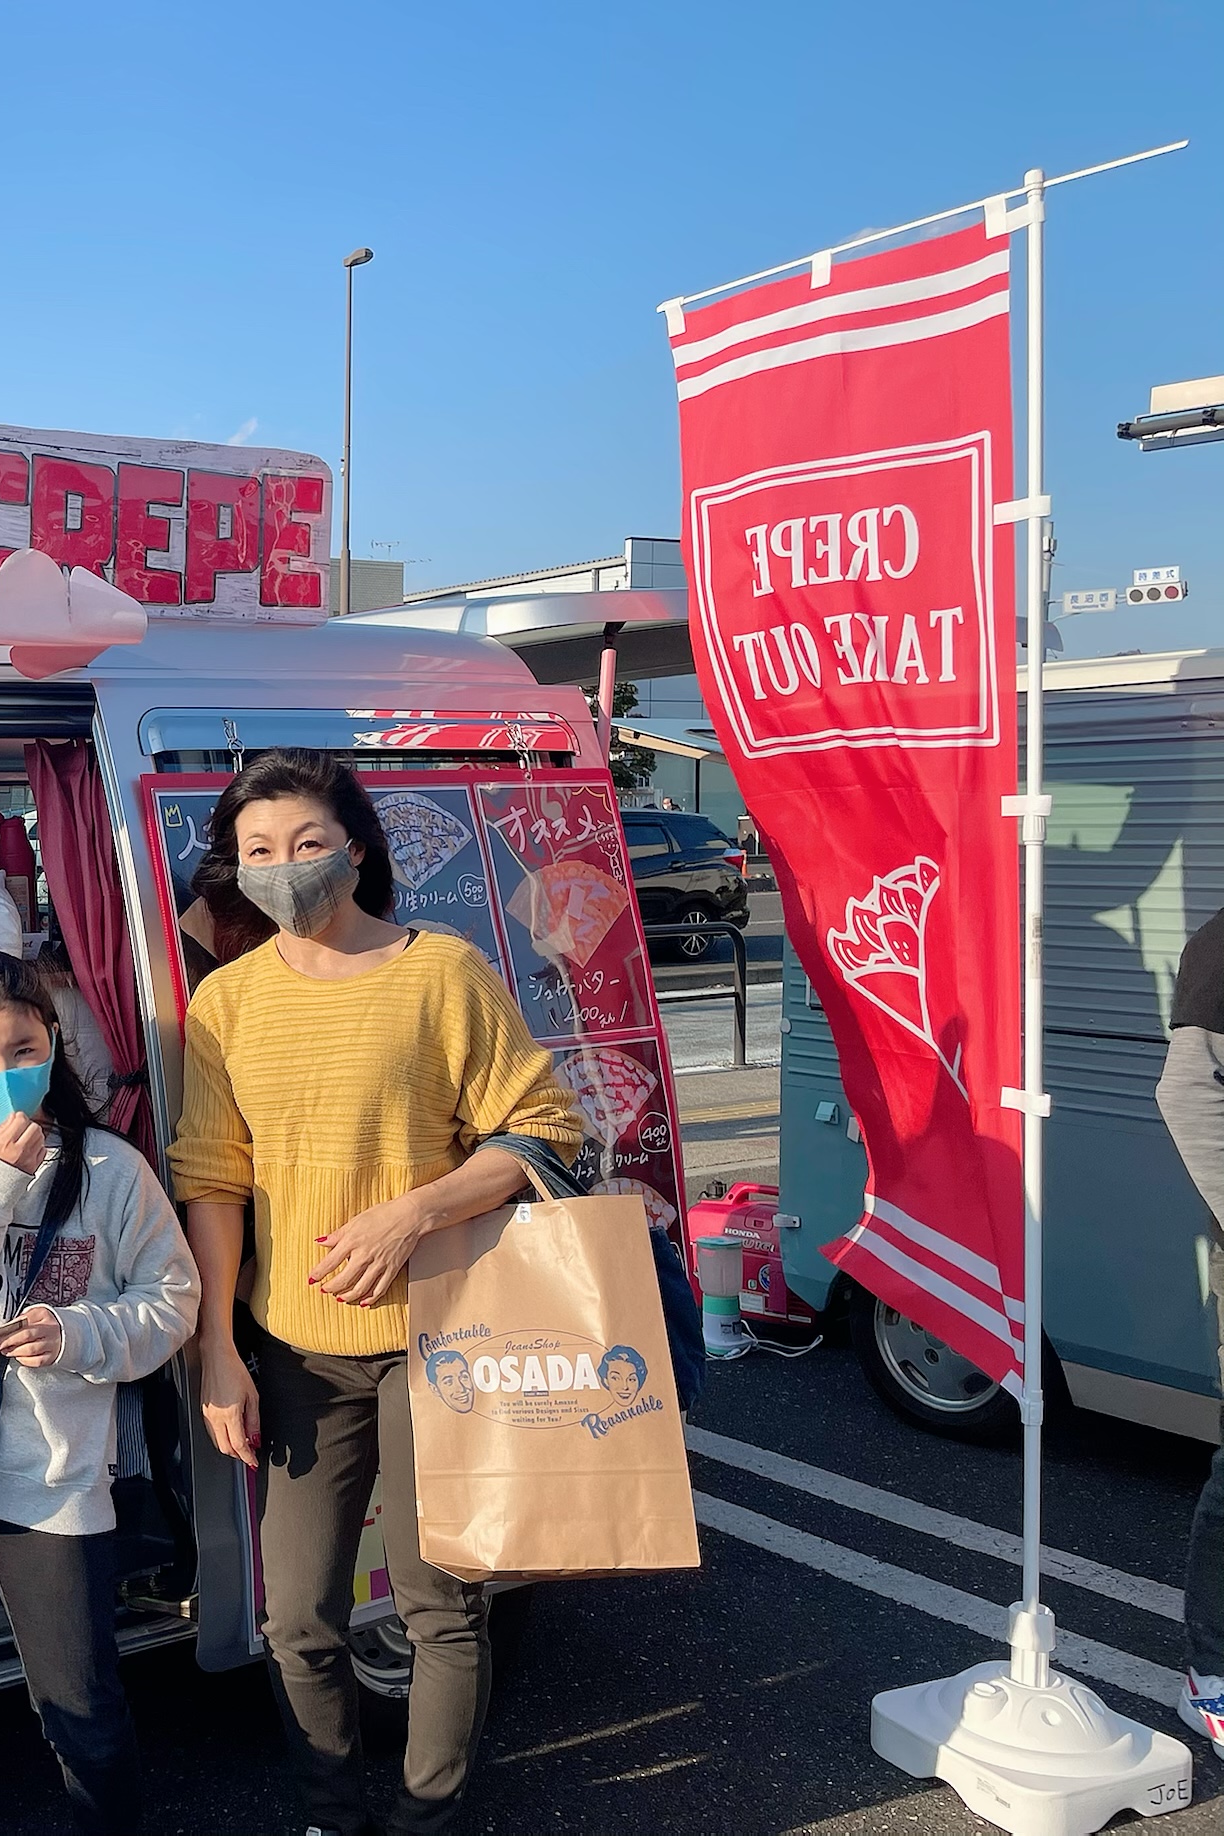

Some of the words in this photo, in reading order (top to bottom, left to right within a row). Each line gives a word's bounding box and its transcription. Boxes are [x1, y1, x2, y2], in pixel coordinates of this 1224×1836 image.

[177, 806, 215, 862] 人
[724, 1227, 761, 1240] HONDA
[418, 1323, 492, 1361] Comfortable
[473, 1353, 601, 1393] OSADA
[580, 1395, 664, 1440] Reasonable
